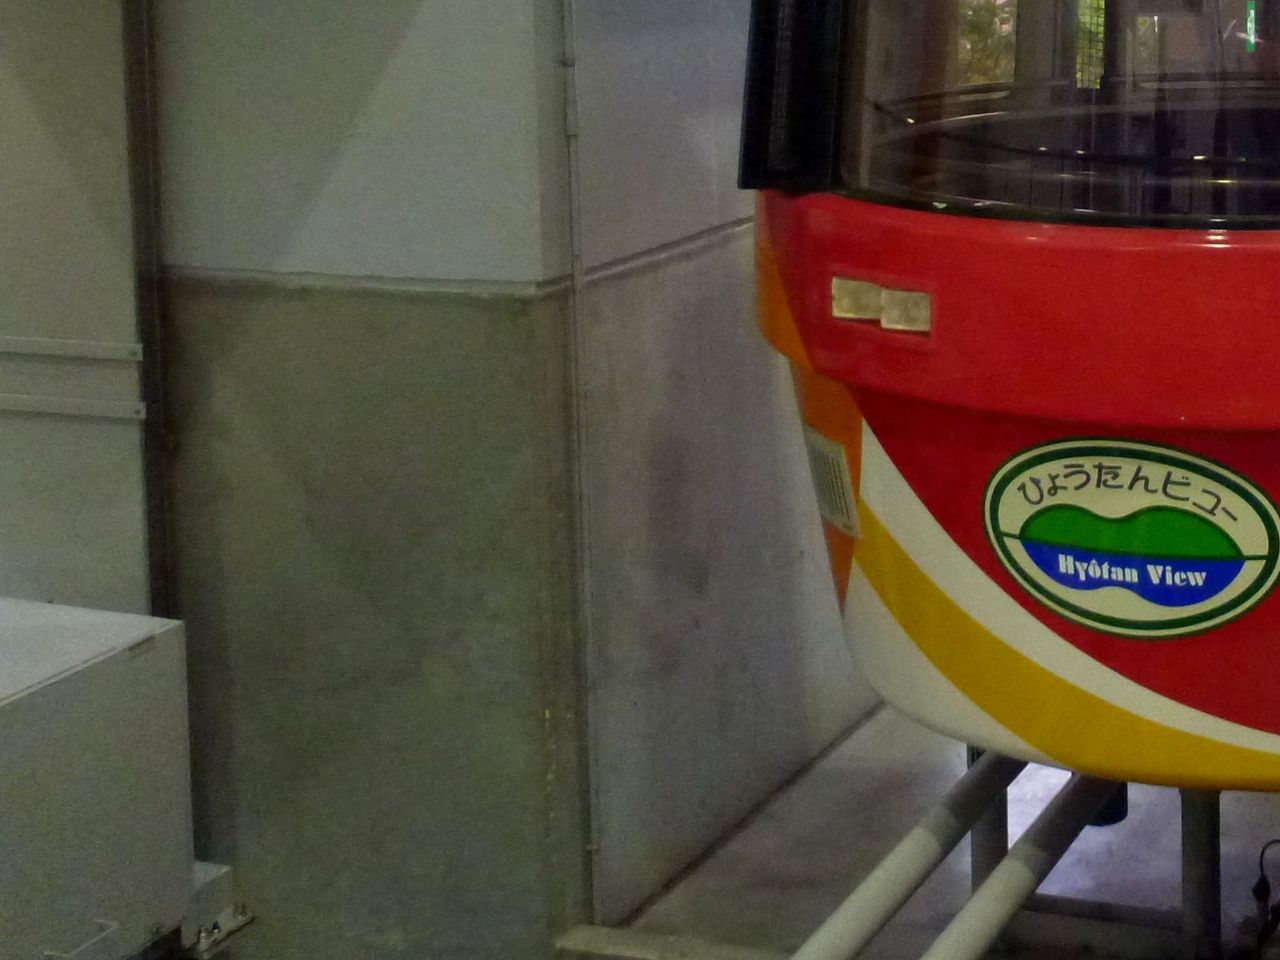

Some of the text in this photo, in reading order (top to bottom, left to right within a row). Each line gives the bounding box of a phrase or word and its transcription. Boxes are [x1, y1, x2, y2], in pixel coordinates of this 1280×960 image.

[1017, 462, 1238, 521] ひょうたんビュー
[1146, 564, 1207, 587] View
